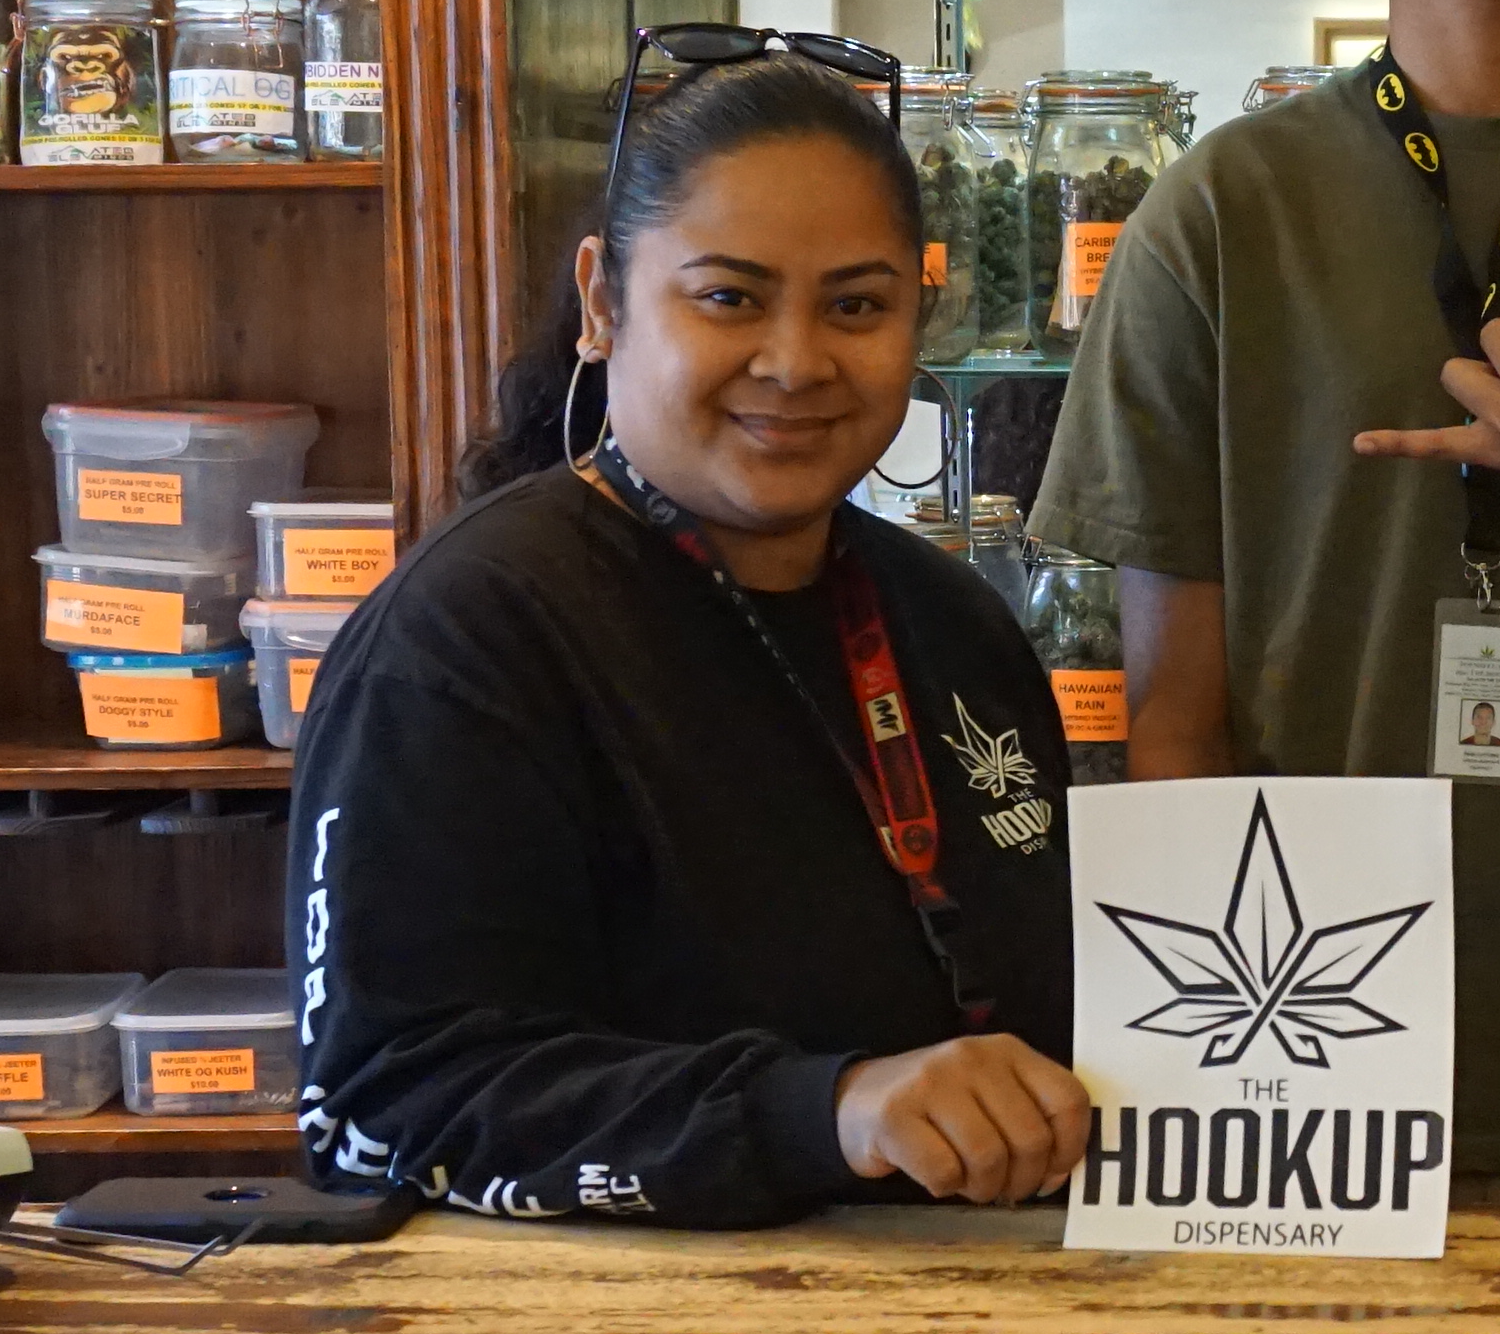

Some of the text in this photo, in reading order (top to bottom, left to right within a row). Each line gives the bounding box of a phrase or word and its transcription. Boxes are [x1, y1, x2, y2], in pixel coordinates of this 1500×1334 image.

[254, 77, 291, 101] OG
[37, 112, 141, 127] GORILLA
[84, 488, 182, 504] SUPER SECRET
[305, 559, 380, 572] WHITE BOY
[63, 608, 142, 627] MURDAFACE
[1058, 683, 1123, 695] HAWAIIAN
[98, 705, 174, 718] DOGGY STYLE
[1074, 700, 1106, 711] RAIN
[1007, 787, 1035, 804] THE
[156, 1065, 248, 1079] WHITE OG KUSH
[1237, 1077, 1290, 1102] THE
[1081, 1106, 1445, 1212] HOOKUP
[1173, 1220, 1344, 1247] DISPENSARY
